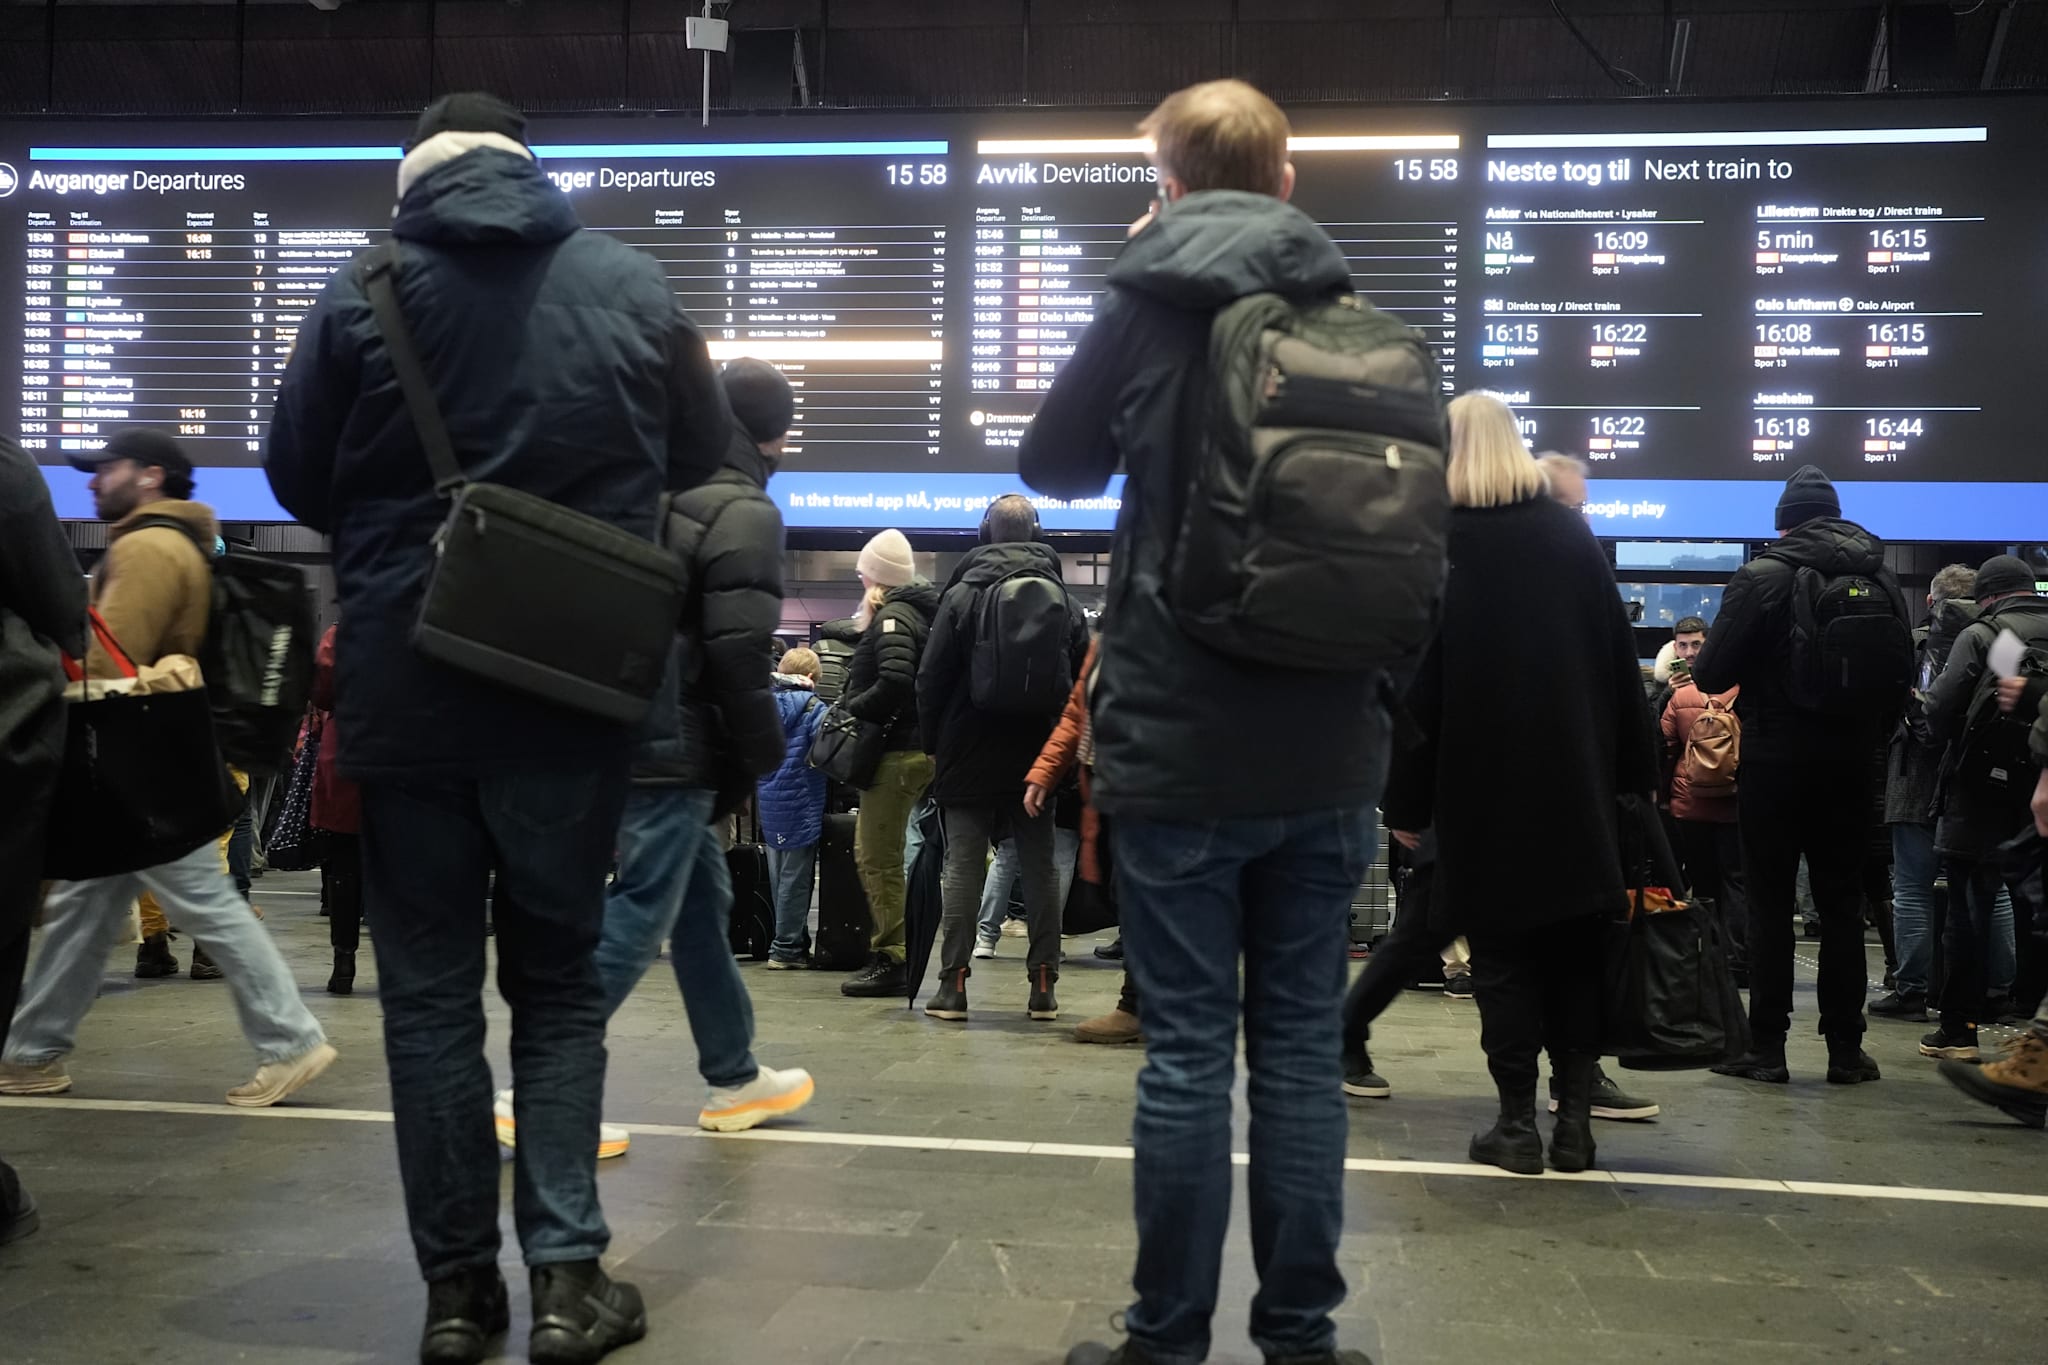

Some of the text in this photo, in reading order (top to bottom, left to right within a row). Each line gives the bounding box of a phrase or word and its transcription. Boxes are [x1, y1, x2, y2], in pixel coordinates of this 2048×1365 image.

[887, 164, 946, 185] 15 58
[977, 162, 1159, 184] Avvik Deviations
[1394, 159, 1458, 180] 15 58
[1488, 158, 1792, 186] Neste tog til Next train to
[29, 170, 244, 194] Avganger Departures
[547, 168, 715, 193] nger Departures
[1485, 207, 1657, 220] Asker via Nationaltheatret Lysaker
[1823, 207, 1856, 216] Direkte
[1859, 208, 1874, 217] tog
[1884, 207, 1912, 215] Direct
[1915, 207, 1942, 215] trains
[254, 234, 266, 243] 13
[726, 232, 738, 241] 19
[1486, 231, 1513, 250] Nå
[1594, 231, 1648, 250] 16:09
[1758, 230, 1813, 249] 5 min
[1870, 229, 1926, 248] 16:15
[254, 250, 265, 259] 11
[728, 247, 735, 257] 8
[256, 266, 263, 275] 7
[725, 264, 737, 274] 13
[1485, 266, 1511, 276] Spor 7
[1592, 266, 1619, 276] Spor 5
[1756, 266, 1776, 275] Spor
[1868, 265, 1888, 274] Spor
[253, 282, 265, 290] 10
[727, 280, 734, 290] 6
[254, 297, 261, 307] 7
[727, 297, 732, 306] 1
[1755, 298, 1784, 311] Oslo
[1857, 301, 1879, 310] Oslo
[1881, 301, 1914, 311] Airport
[1507, 302, 1539, 310] Direkte
[1541, 303, 1556, 312] tog
[1565, 302, 1592, 310] Direct
[1594, 302, 1620, 310] trains
[251, 313, 264, 323] 15
[725, 313, 733, 322] 3
[254, 329, 260, 338] 8
[721, 329, 736, 340] 10
[1485, 324, 1538, 342] 16:15
[1593, 324, 1646, 342] 16:22
[1756, 324, 1811, 343] 16:08
[1868, 324, 1924, 342] 16:15
[252, 345, 260, 354] 6
[252, 361, 259, 371] 3
[1483, 358, 1514, 368] Spor 18
[1591, 359, 1610, 368] Spor
[1755, 359, 1786, 368] Spor 13
[1866, 359, 1898, 368] Spor 11
[252, 377, 259, 387] 5
[251, 393, 258, 402] 7
[250, 409, 257, 419] 9
[247, 425, 258, 434] 11
[1591, 417, 1645, 435] 16:22
[1755, 418, 1810, 436] 16:18
[1867, 418, 1923, 436] 16:44
[247, 441, 259, 451] 18
[1589, 451, 1608, 461] Spor
[1753, 453, 1784, 462] Spor 11
[1865, 453, 1885, 463] Spor
[790, 493, 804, 507] In
[806, 493, 831, 507] the
[832, 493, 874, 508] travel
[874, 496, 904, 511] app
[905, 491, 932, 510] NÅ,
[933, 497, 962, 511] you
[963, 496, 989, 512] get
[1581, 500, 1666, 518] oogle play
